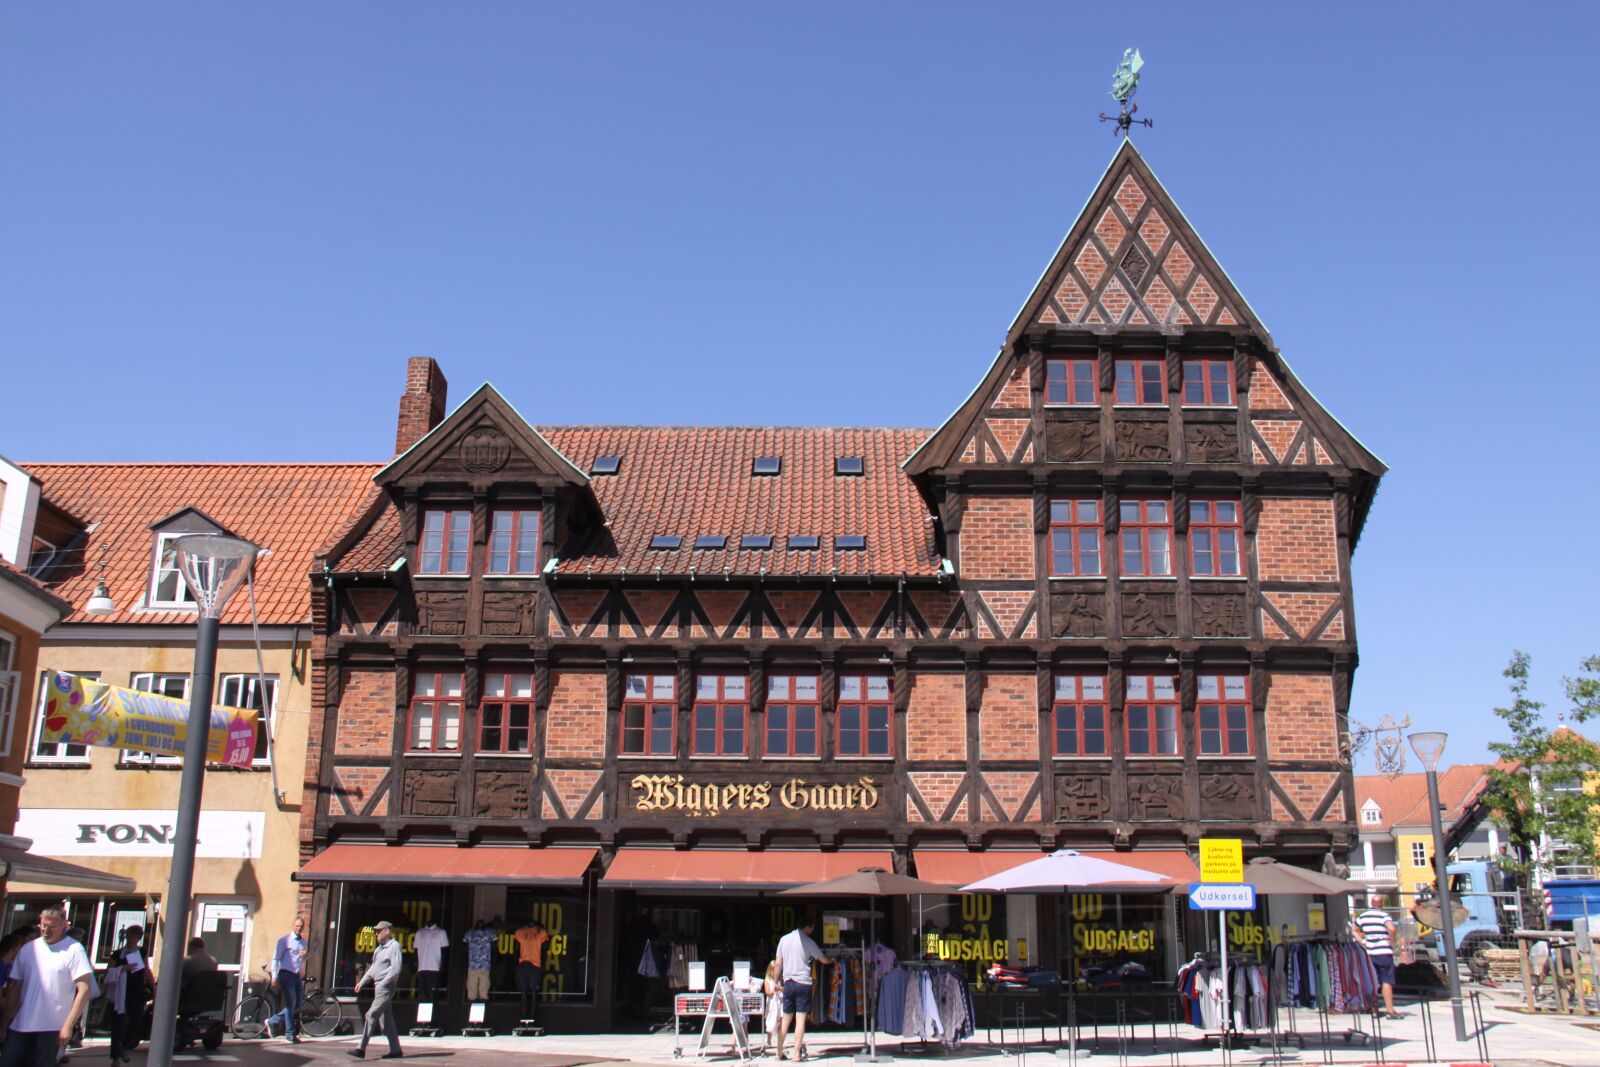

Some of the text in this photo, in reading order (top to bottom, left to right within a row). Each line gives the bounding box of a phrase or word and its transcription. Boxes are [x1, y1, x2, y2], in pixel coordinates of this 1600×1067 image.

[1099, 112, 1106, 123] S
[1144, 118, 1153, 128] N
[631, 774, 878, 817] Wiggers Gaard
[1199, 891, 1249, 901] Udkørsel
[1084, 929, 1155, 951] UDSALG!
[938, 939, 1009, 961] UDSALG!
